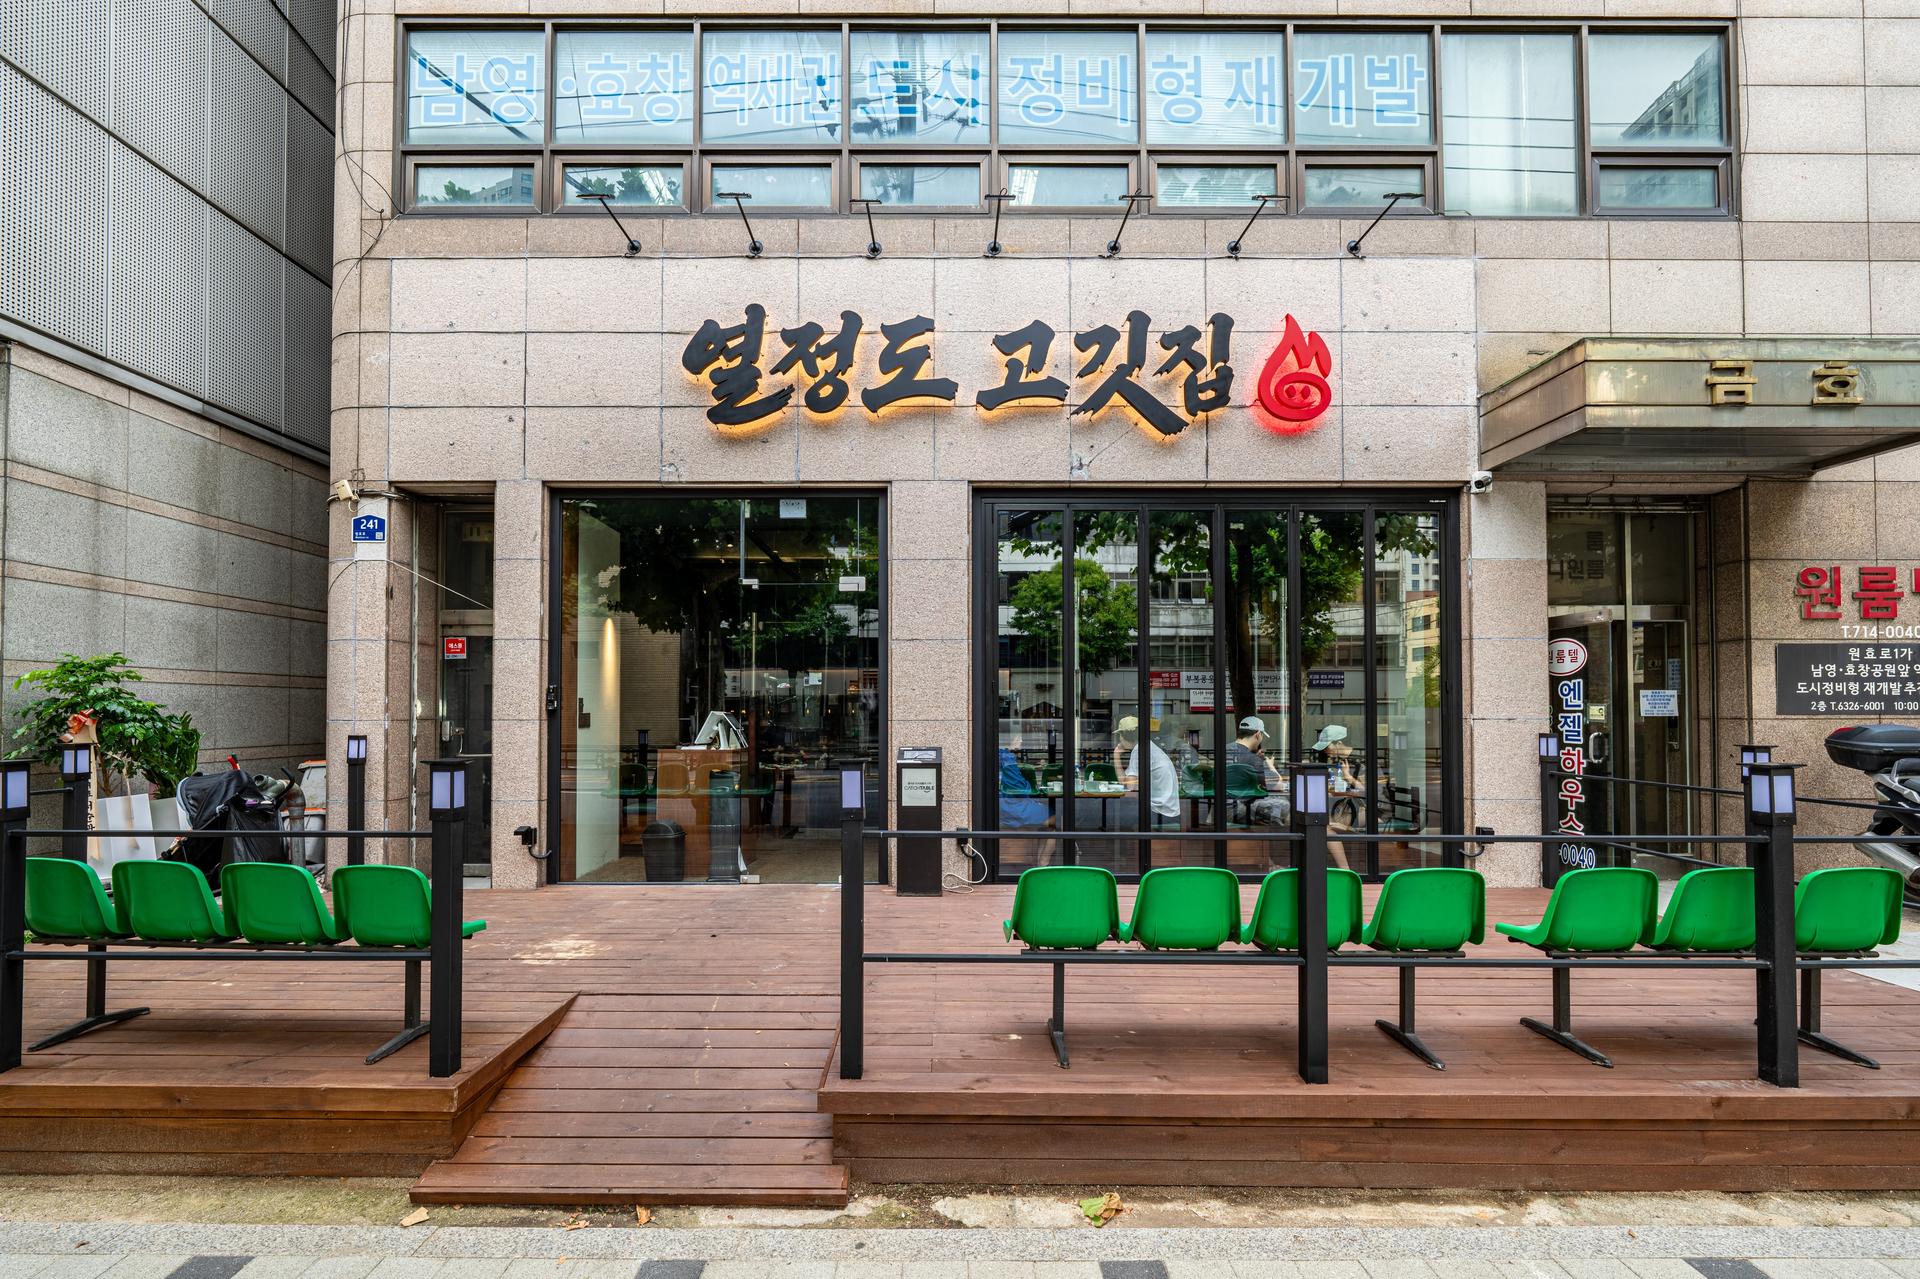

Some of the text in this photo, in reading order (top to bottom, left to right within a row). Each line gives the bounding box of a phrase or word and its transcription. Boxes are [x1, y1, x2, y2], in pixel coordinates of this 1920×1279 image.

[707, 52, 839, 126] 역세권
[1223, 53, 1427, 127] 재개발
[681, 303, 1235, 436] 열정도 고깃집
[360, 519, 378, 529] 241
[1795, 566, 1920, 620] 원룸
[1841, 625, 1920, 639] T.714-0040
[1796, 681, 1860, 696] 도시정비형
[1863, 681, 1902, 696] 재개발
[1810, 701, 1919, 711] 2층 T.6326-6001 10:00
